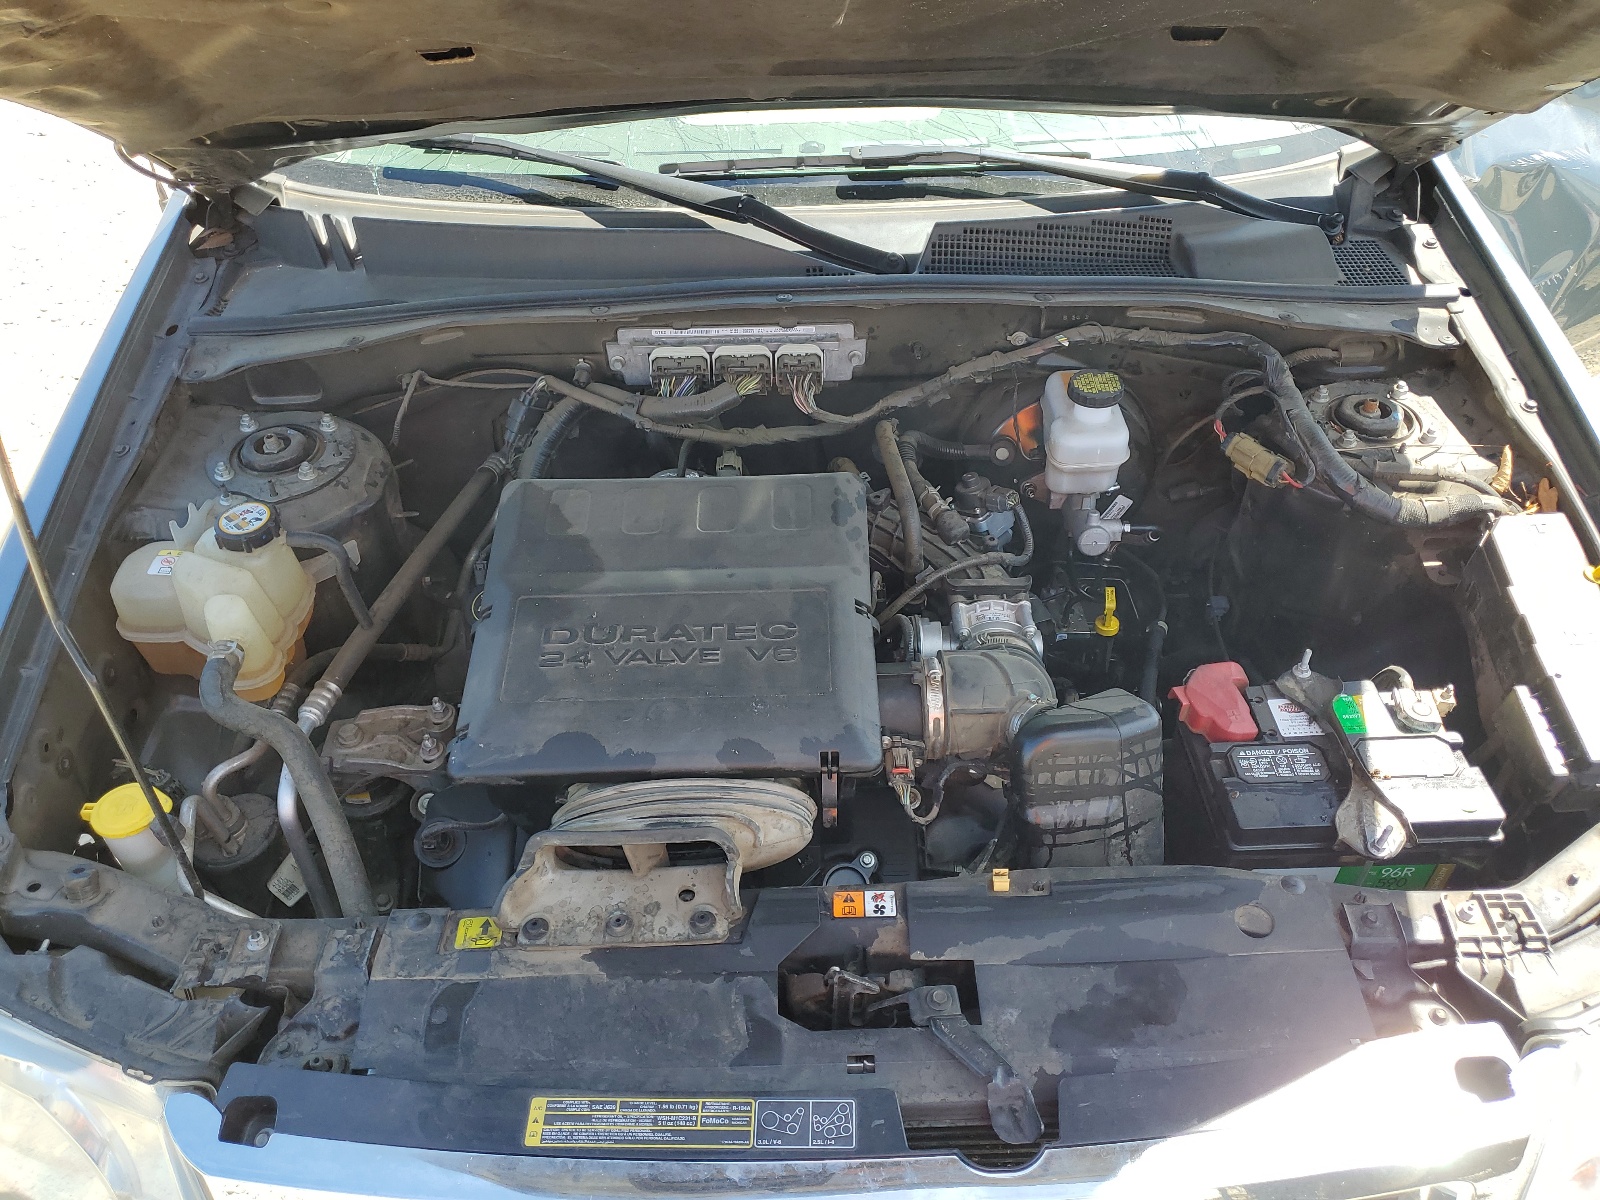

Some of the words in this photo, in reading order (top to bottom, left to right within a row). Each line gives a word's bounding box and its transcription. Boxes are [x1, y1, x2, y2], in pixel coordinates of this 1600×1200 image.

[541, 620, 798, 645] DURATEC
[538, 650, 592, 668] 24
[604, 647, 721, 666] VALVE
[746, 645, 798, 662] V6
[1381, 867, 1416, 878] 96R
